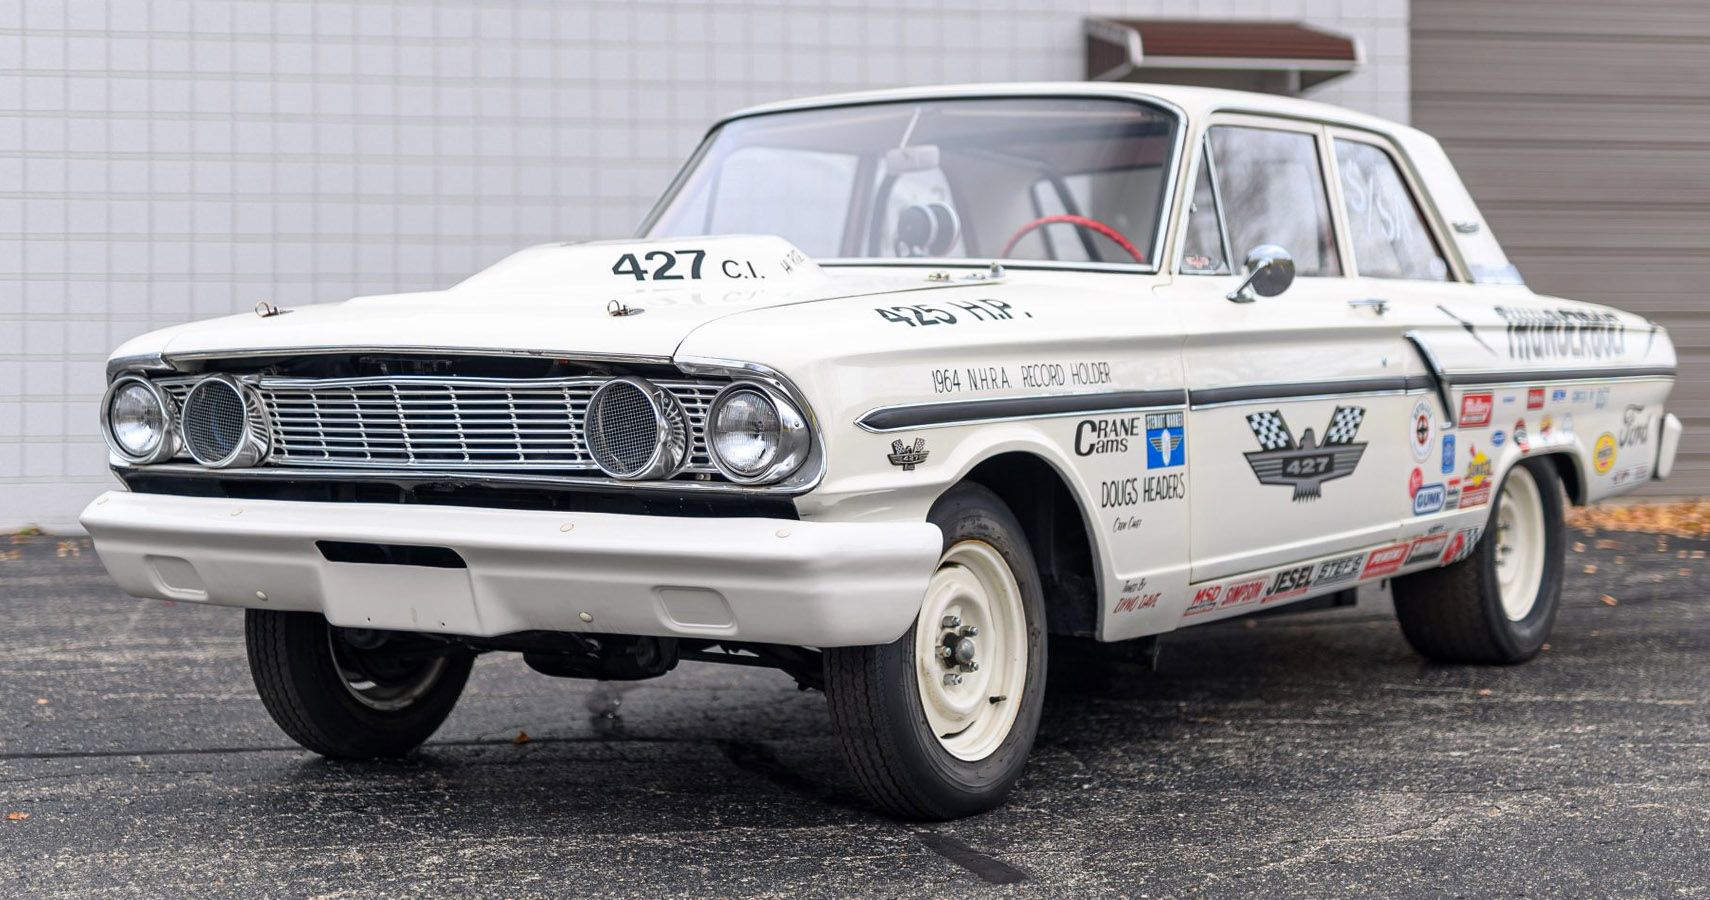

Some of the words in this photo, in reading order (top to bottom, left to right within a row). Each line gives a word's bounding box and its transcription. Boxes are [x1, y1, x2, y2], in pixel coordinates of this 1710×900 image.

[612, 249, 706, 281] 427
[721, 259, 766, 279] C.I.
[874, 304, 957, 327] 425
[947, 299, 1033, 321] H.P.
[931, 369, 961, 394] 1964
[967, 366, 1012, 391] N.H.R.A.
[1021, 363, 1065, 388] RECORD
[1070, 361, 1112, 385] HOLDER
[1619, 403, 1652, 448] Ford
[1286, 456, 1330, 475] 427
[1143, 472, 1185, 503] HEADERS
[1416, 491, 1441, 508] GUNK
[1191, 585, 1222, 606] MSD
[1266, 565, 1314, 596] JESEL
